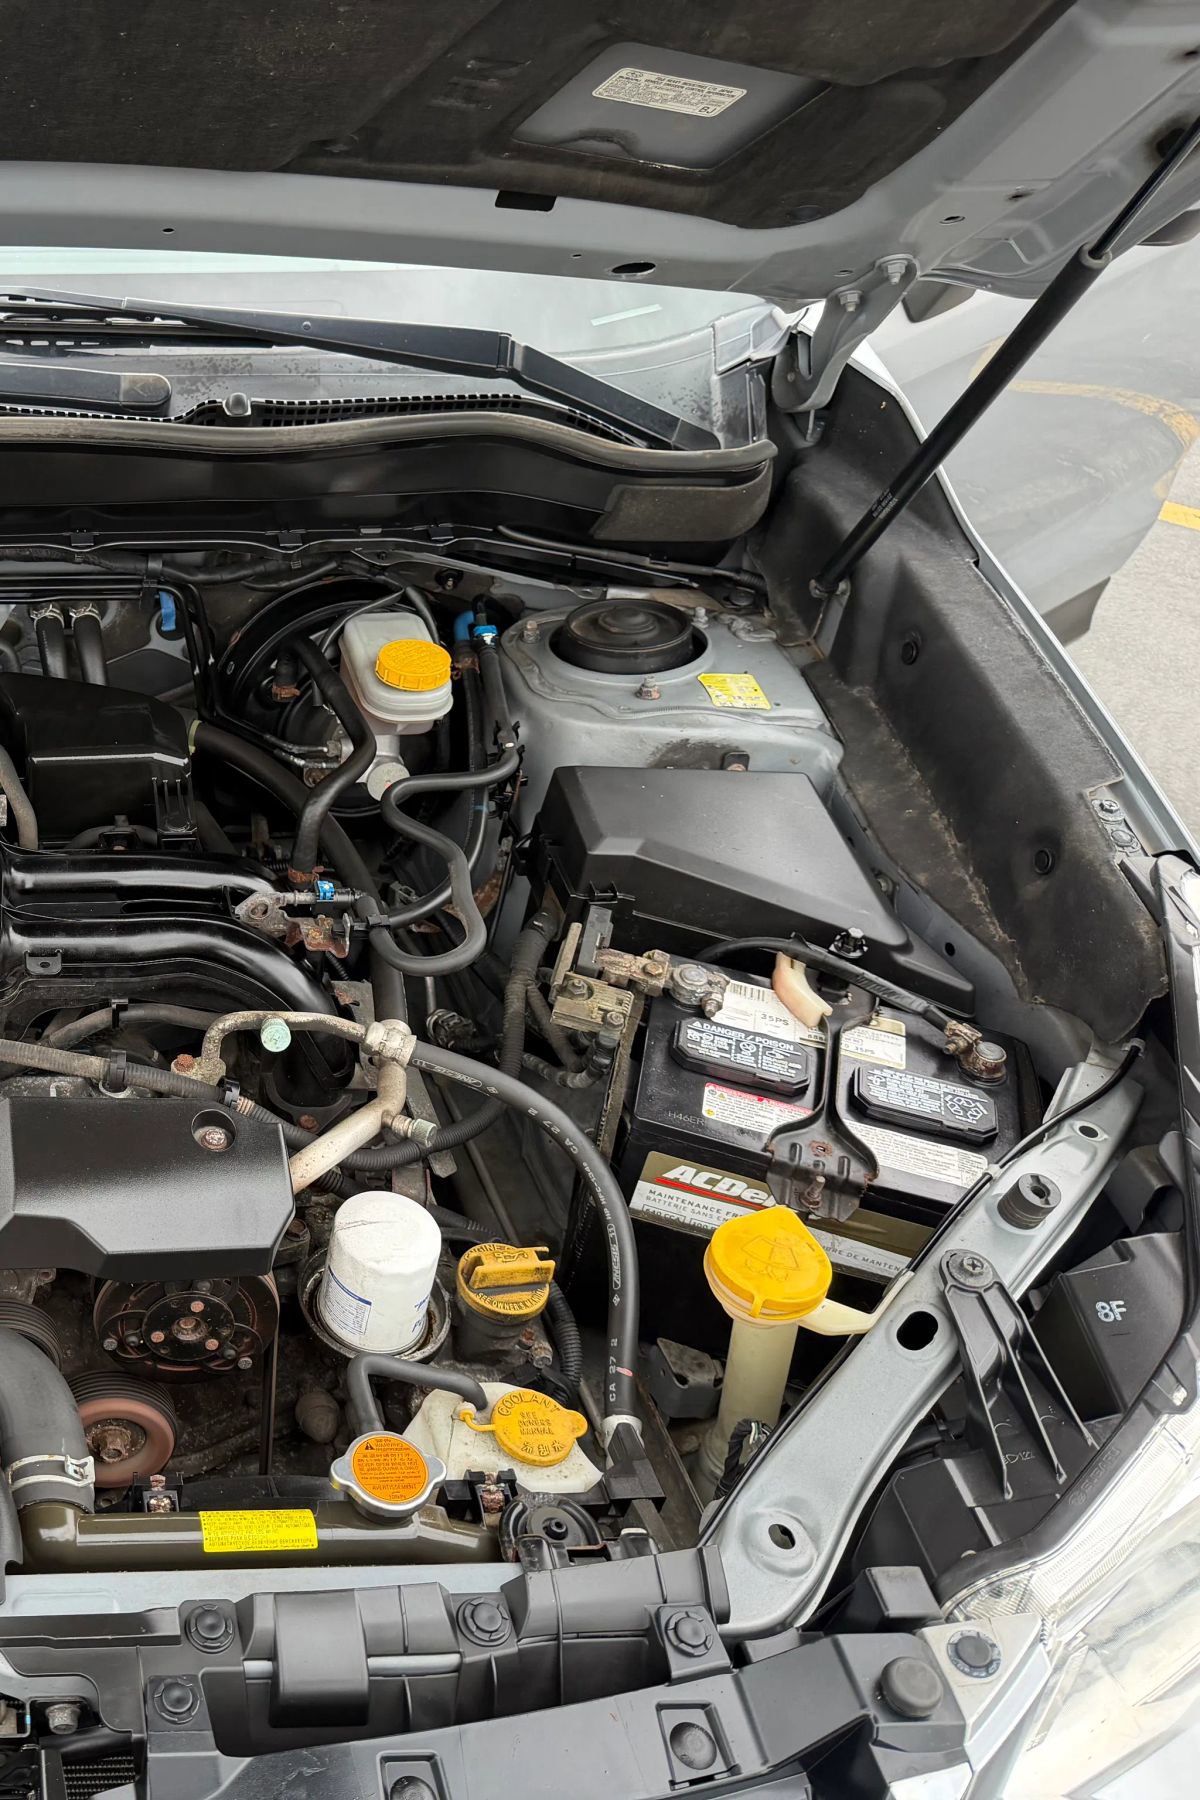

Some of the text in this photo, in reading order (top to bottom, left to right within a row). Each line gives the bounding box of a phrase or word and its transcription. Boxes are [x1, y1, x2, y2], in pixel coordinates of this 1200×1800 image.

[761, 1013, 790, 1026] 35PS
[702, 1022, 746, 1041] DANGER
[755, 1036, 795, 1052] POISON
[527, 1107, 579, 1155] CA 27 2
[645, 1195, 688, 1213] BATTERIE
[689, 1206, 714, 1220] SANS
[648, 1188, 744, 1219] MAINTENANCE FR
[846, 1252, 858, 1260] DE
[476, 1292, 492, 1305] SEE
[492, 1300, 526, 1312] OWNER'S
[1095, 1300, 1127, 1322] 8F
[609, 1338, 618, 1402] CA 27 2
[498, 1392, 560, 1416] COOLANT
[519, 1411, 537, 1420] SEE
[519, 1426, 555, 1436] MANUAL
